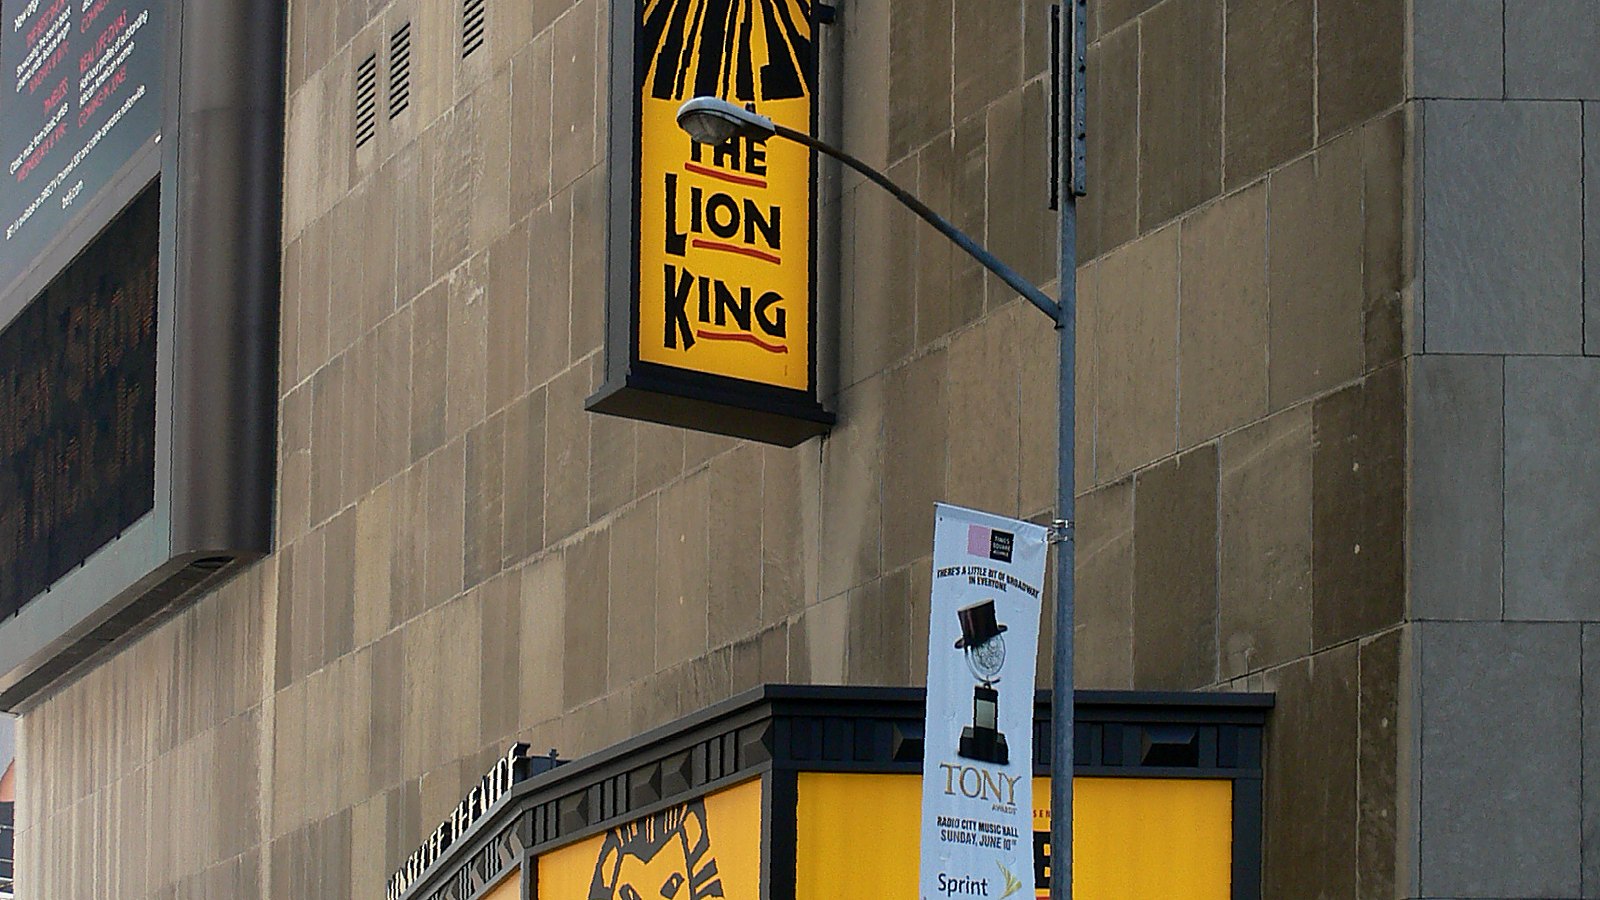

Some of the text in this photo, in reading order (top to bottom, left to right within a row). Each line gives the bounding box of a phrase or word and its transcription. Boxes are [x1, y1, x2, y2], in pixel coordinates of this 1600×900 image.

[664, 173, 780, 257] LION
[664, 264, 787, 351] KING
[937, 566, 1040, 599] THERE'S A LITTLE BIT OF BROADWAY
[968, 576, 1007, 592] IN EVERYONE
[940, 762, 1022, 806] TONY
[937, 816, 1019, 838] RADIO CITY MUSIC HALL
[940, 830, 978, 847] SUNDAY,
[979, 834, 1001, 849] JUNE
[937, 873, 988, 897] Sprint
